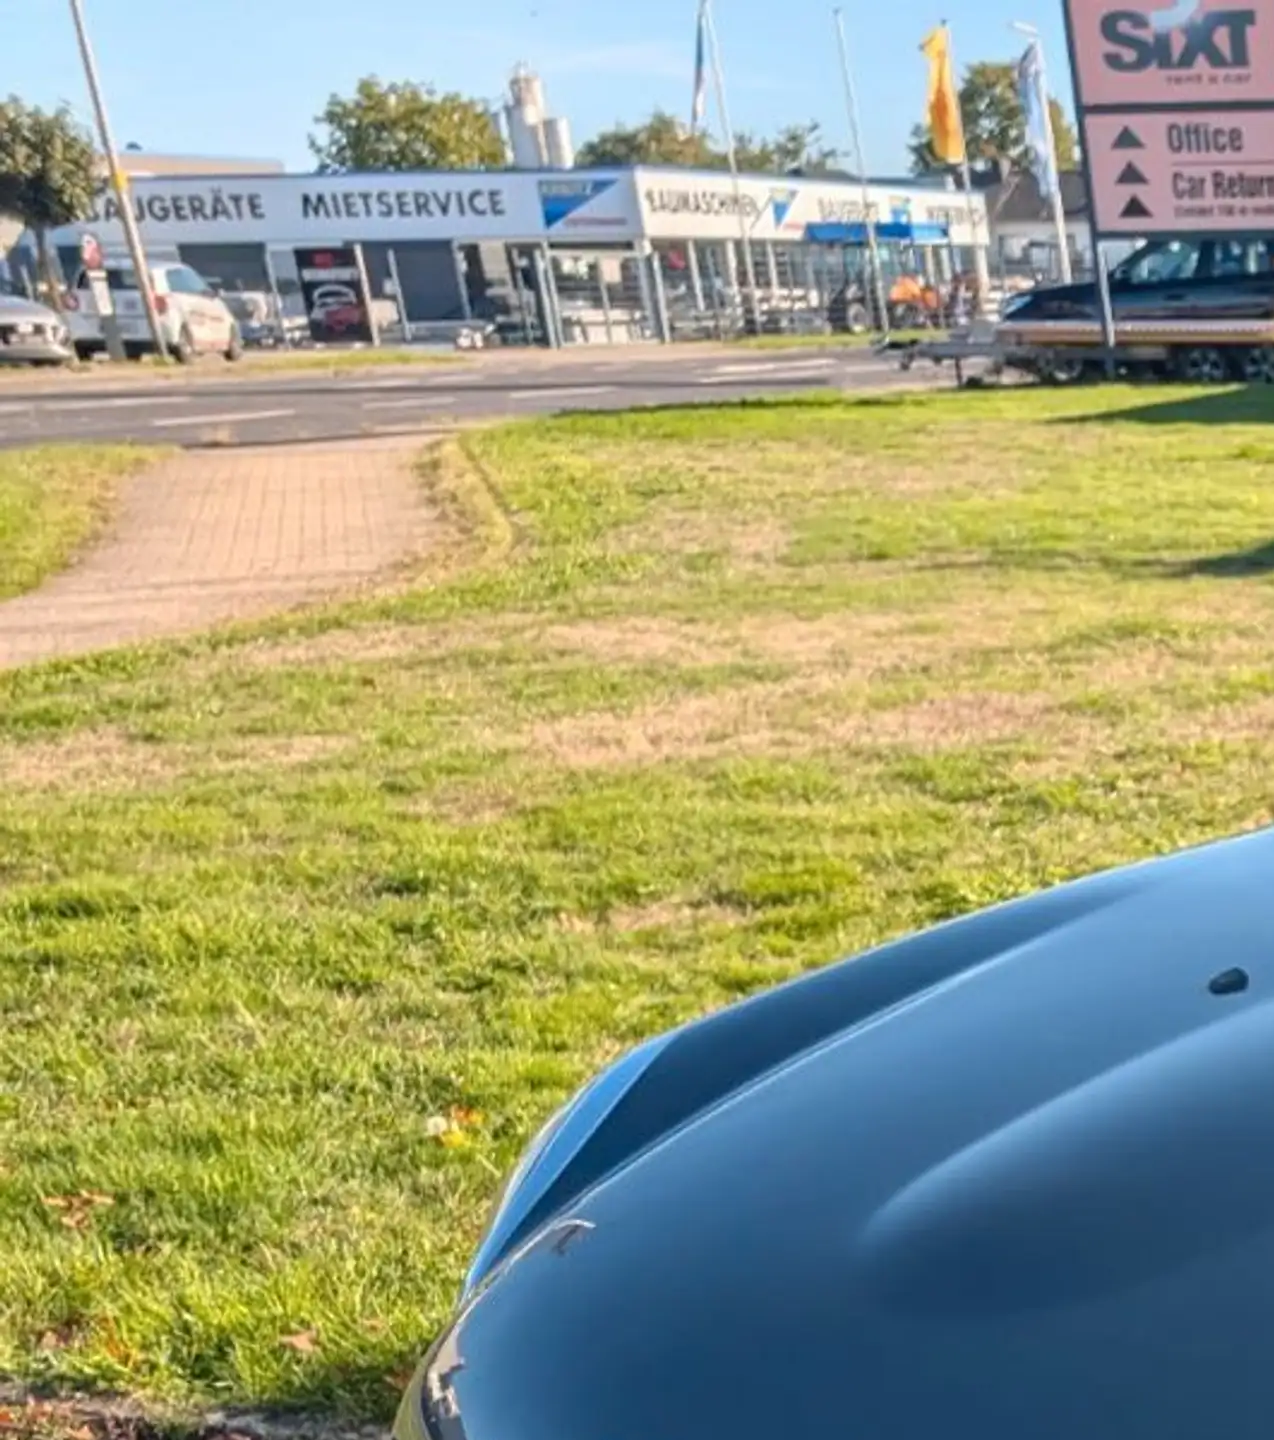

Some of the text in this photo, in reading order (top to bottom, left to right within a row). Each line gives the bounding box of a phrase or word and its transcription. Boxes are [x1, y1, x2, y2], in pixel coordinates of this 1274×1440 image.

[1167, 122, 1244, 153] Office
[1172, 171, 1206, 200] Car
[91, 185, 506, 223] AUGERÄTE MIETSERVICE
